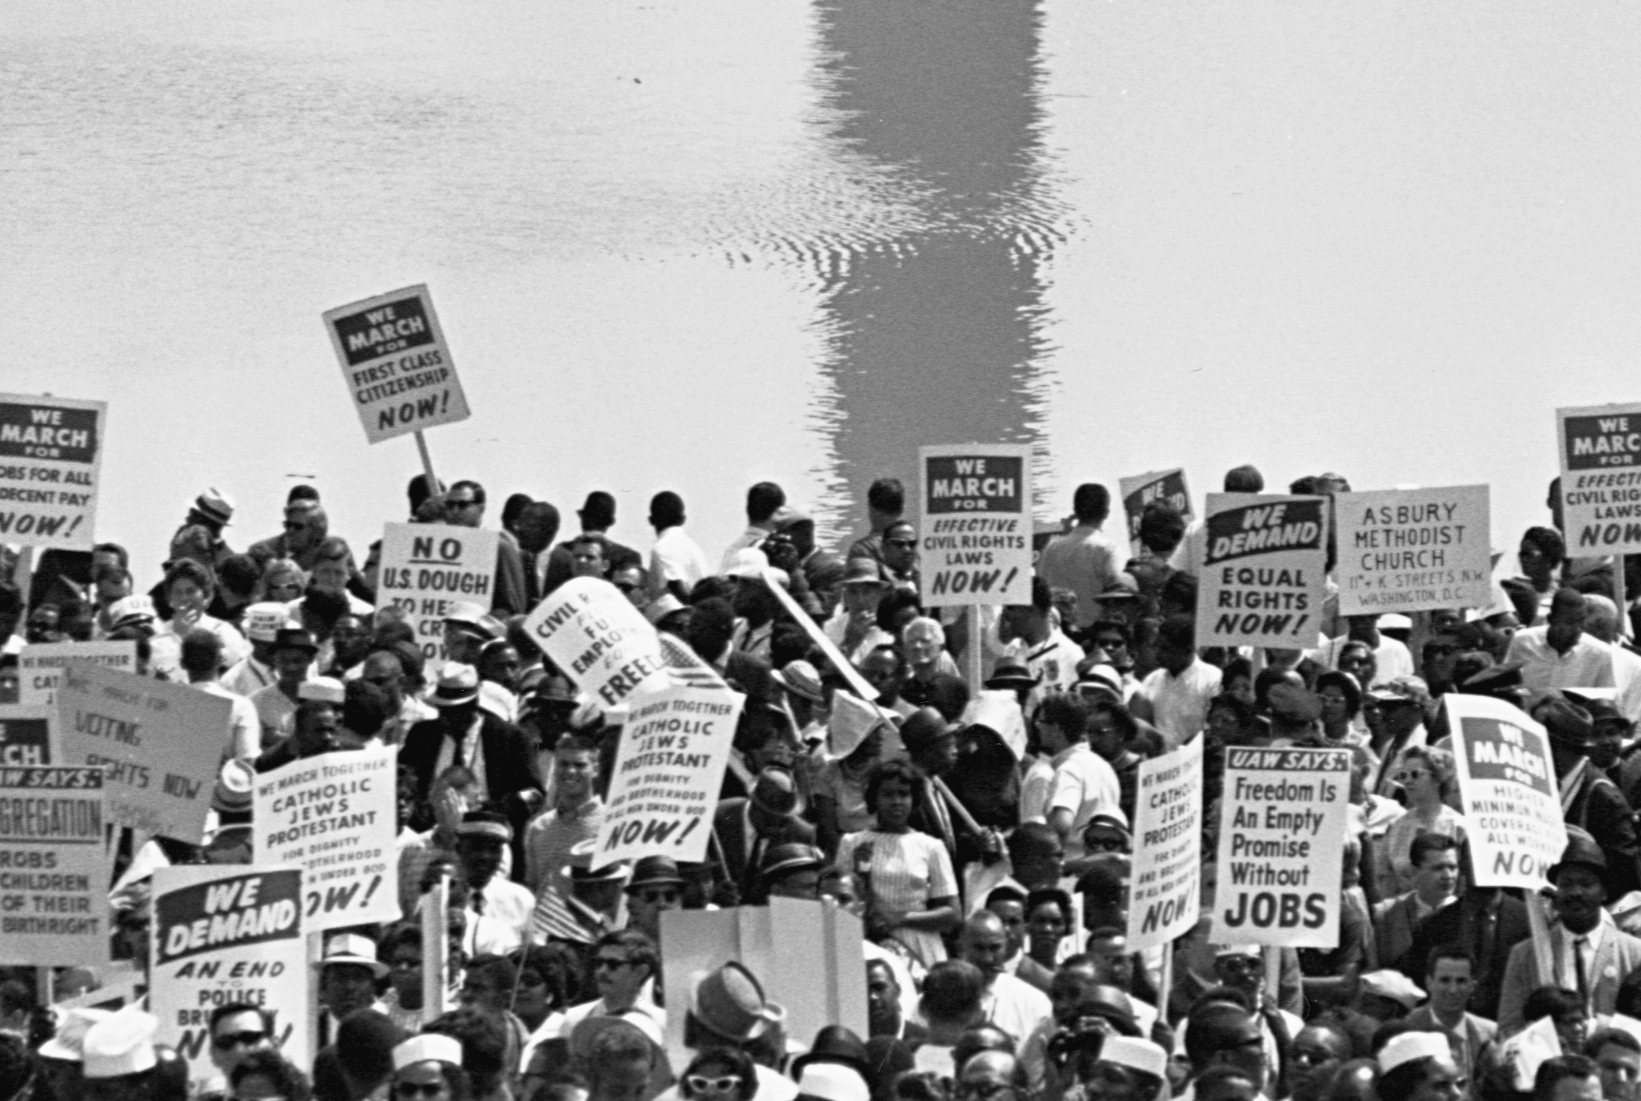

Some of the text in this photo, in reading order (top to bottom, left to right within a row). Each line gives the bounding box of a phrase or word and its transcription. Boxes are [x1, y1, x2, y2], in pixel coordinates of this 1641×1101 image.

[366, 307, 396, 325] WE
[348, 316, 424, 352] MARCH
[376, 339, 407, 353] FOR
[353, 351, 442, 387] FIRST CLASS
[356, 368, 449, 404] CITIZENSHIP
[31, 409, 62, 425] WE
[378, 390, 449, 430] NOW!
[1599, 417, 1629, 433] WE
[1, 424, 88, 448] MARCH
[25, 447, 60, 458] FOR
[1600, 455, 1633, 465] FOR
[29, 468, 92, 486] FOR ALL
[956, 459, 986, 475] WE
[932, 477, 1014, 498] MARCH
[58, 492, 91, 506] PAY
[954, 500, 987, 509] FOR
[1566, 491, 1607, 505] CIVIL
[1242, 504, 1287, 529] WE
[1363, 502, 1457, 525] ASBURY
[933, 518, 1018, 533] EFFECTIVE
[923, 535, 1025, 550] CIVIL RIGHTS
[1211, 521, 1318, 559] DEMAND
[1355, 525, 1466, 548] METHODIST
[412, 537, 462, 560] NO
[946, 551, 993, 565] LAWS
[1361, 550, 1445, 571] CHURCH
[418, 569, 489, 595] DOUGH
[932, 566, 1018, 595] NOW!
[1222, 567, 1306, 587] EQUAL
[1396, 570, 1455, 587] STREETS
[1218, 590, 1309, 610] RIGHTS
[536, 602, 579, 638] CIVIL
[1214, 613, 1310, 635] NOW!
[672, 699, 733, 715] TOGETHER
[75, 709, 142, 747] VOTING
[631, 718, 715, 740] CATHOLIC
[639, 735, 689, 752] JEWS
[620, 751, 712, 774] PROTESTANT
[1231, 751, 1348, 771] UAW SAYS:
[1474, 740, 1546, 780] MARCH
[29, 769, 101, 788] SAYS:
[162, 773, 202, 799] NOW
[258, 758, 388, 797] WE MARCH TOGETHER
[643, 773, 691, 785] DIGNITY
[1505, 767, 1533, 786] FOR
[272, 778, 371, 813] CATHOLIC
[628, 787, 706, 801] BROTHERHOOD
[1235, 776, 1337, 802] Freedom Is
[289, 798, 349, 825] JEWS
[646, 802, 680, 814] UNDER
[1471, 800, 1530, 816] MINIMUM
[267, 811, 377, 848] PROTESTANT
[1232, 805, 1324, 836] An Empty
[604, 816, 700, 851] NOW!
[1487, 832, 1511, 845] ALL
[283, 836, 360, 861] FOR DIGNITY
[1231, 833, 1310, 858] Promise
[0, 851, 57, 869] ROBS
[1, 873, 89, 891] CHILDREN
[320, 863, 386, 881] UNDER GOD
[1230, 862, 1310, 886] Without
[2, 895, 91, 914] OF THEIR
[204, 877, 263, 914] WE
[1224, 892, 1327, 929] JOBS
[2, 917, 99, 935] BIRTHRIGHT
[165, 899, 296, 955] DEMAND
[174, 961, 286, 979] AN END
[219, 980, 243, 988] TO
[199, 989, 266, 1006] POLICE
